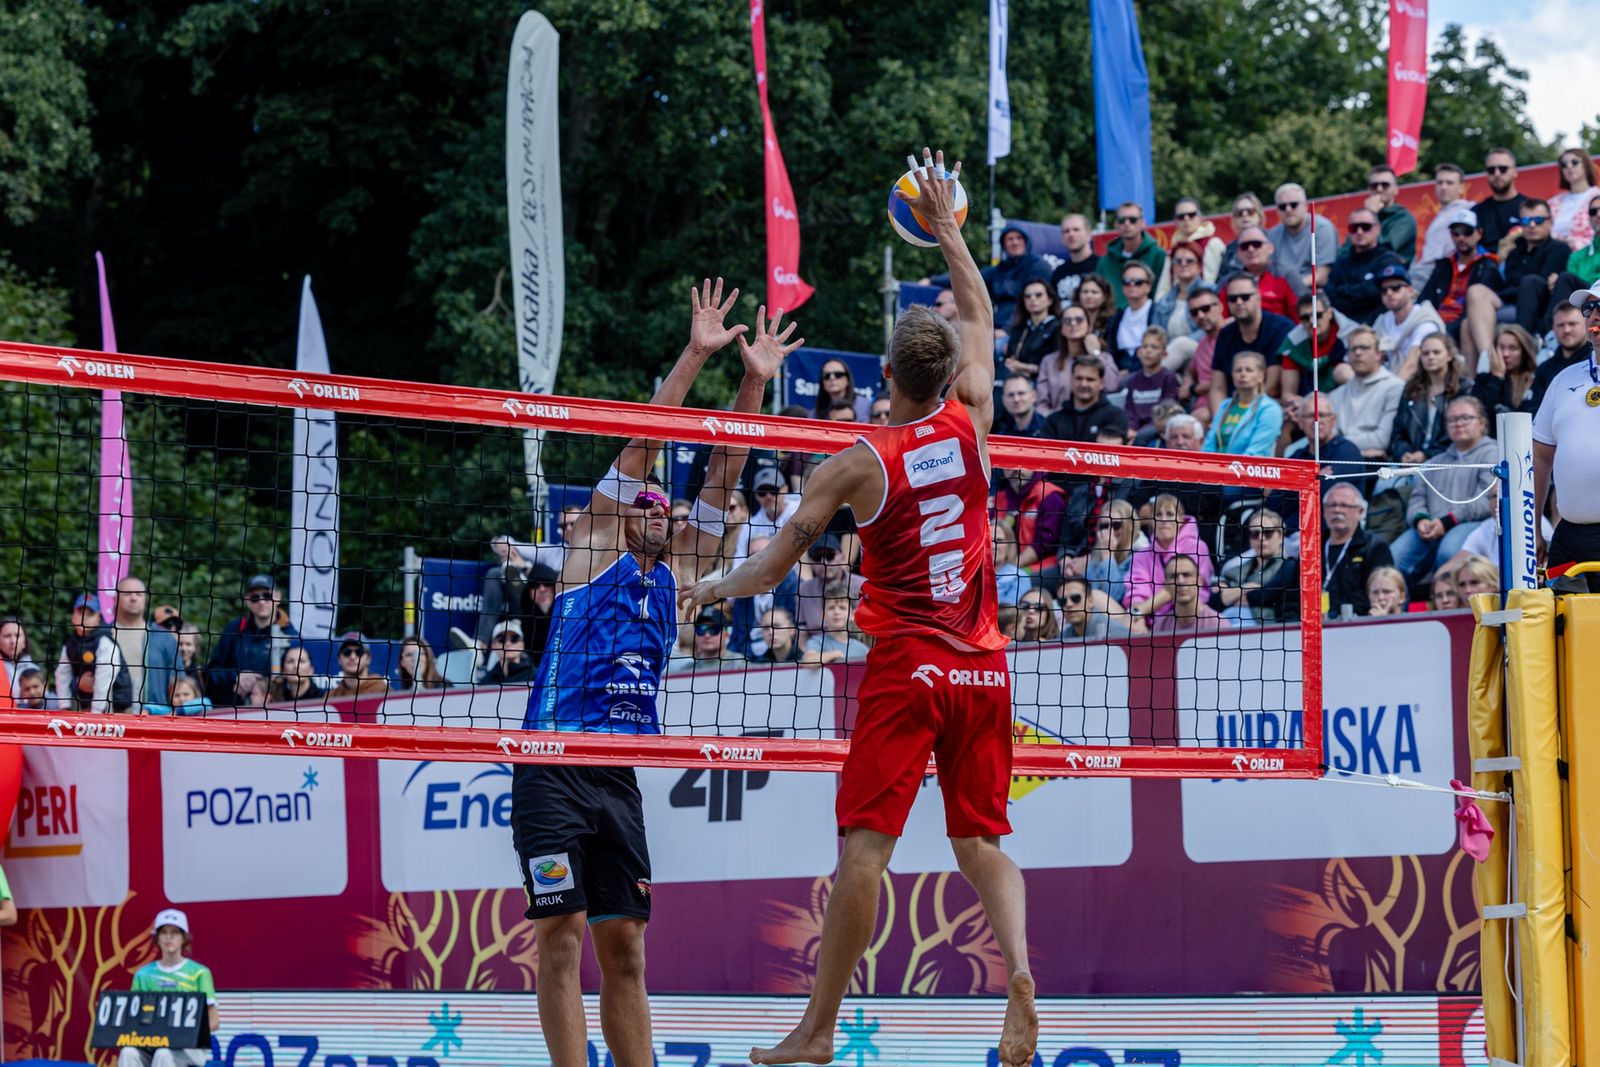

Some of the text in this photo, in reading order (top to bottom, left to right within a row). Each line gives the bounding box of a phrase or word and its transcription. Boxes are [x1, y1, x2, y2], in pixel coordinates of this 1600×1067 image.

[84, 361, 135, 380] ORLEN
[313, 383, 360, 401] ORLEN
[525, 403, 570, 420] ORLEN
[724, 421, 766, 437] ORLEN
[1083, 452, 1120, 467] ORLEN
[1246, 465, 1281, 479] ORLEN
[918, 493, 965, 548] 2
[637, 594, 650, 619] 1
[948, 669, 1006, 687] ORLEN
[609, 707, 653, 723] Enea
[75, 722, 126, 737] ORLEN
[306, 732, 353, 747] ORLEN
[521, 740, 566, 755] ORLEN
[722, 747, 764, 761] ORLEN
[1085, 755, 1122, 768] ORLEN
[1250, 758, 1284, 771] ORLEN
[17, 784, 78, 838] PERI
[423, 782, 513, 830] Ene
[535, 895, 563, 907] KRUK
